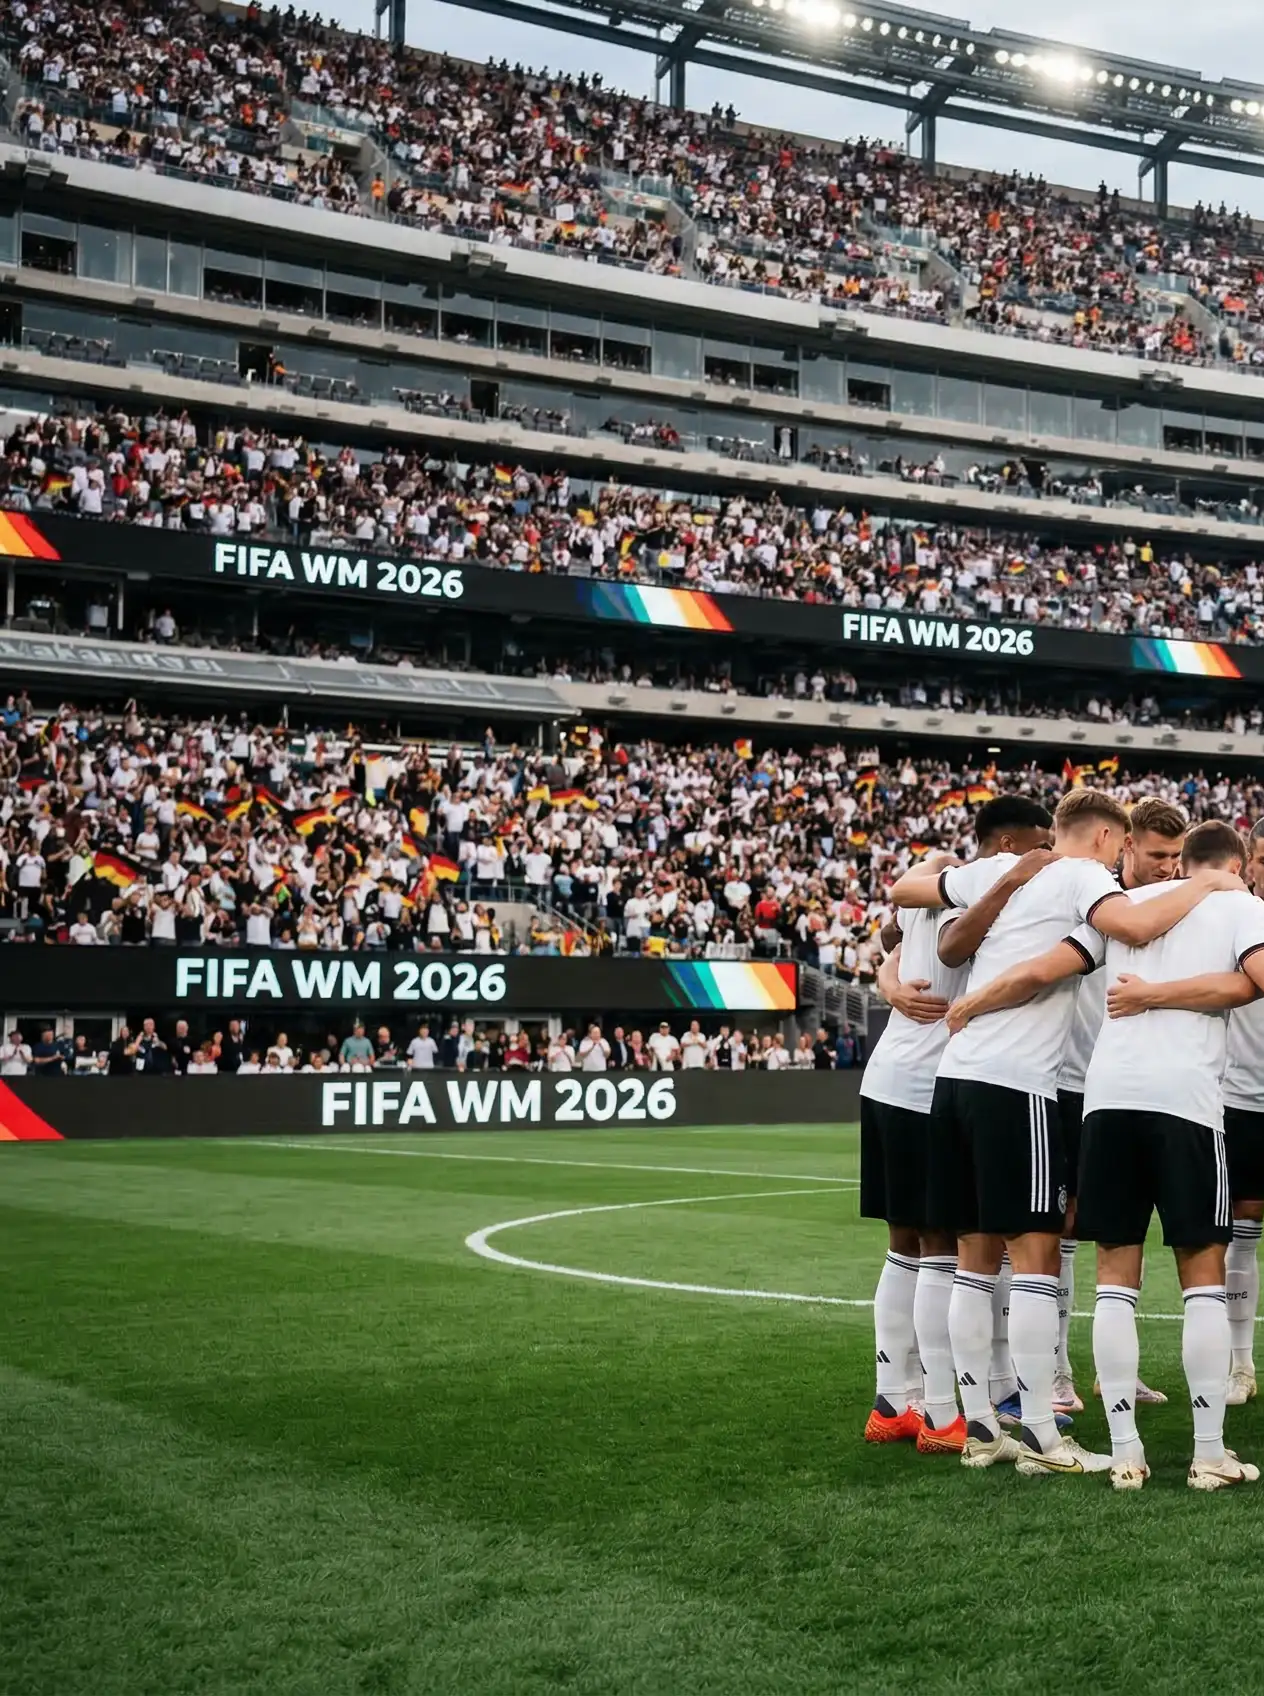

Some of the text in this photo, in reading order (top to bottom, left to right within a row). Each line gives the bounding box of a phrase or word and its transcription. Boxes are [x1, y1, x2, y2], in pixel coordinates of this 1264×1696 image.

[215, 542, 464, 599] FIFA WM 2026
[843, 613, 1034, 656] FIFA WM 2026
[176, 957, 507, 1002] FIFA WM 2026
[321, 1077, 677, 1126] FIFA WM 2026
